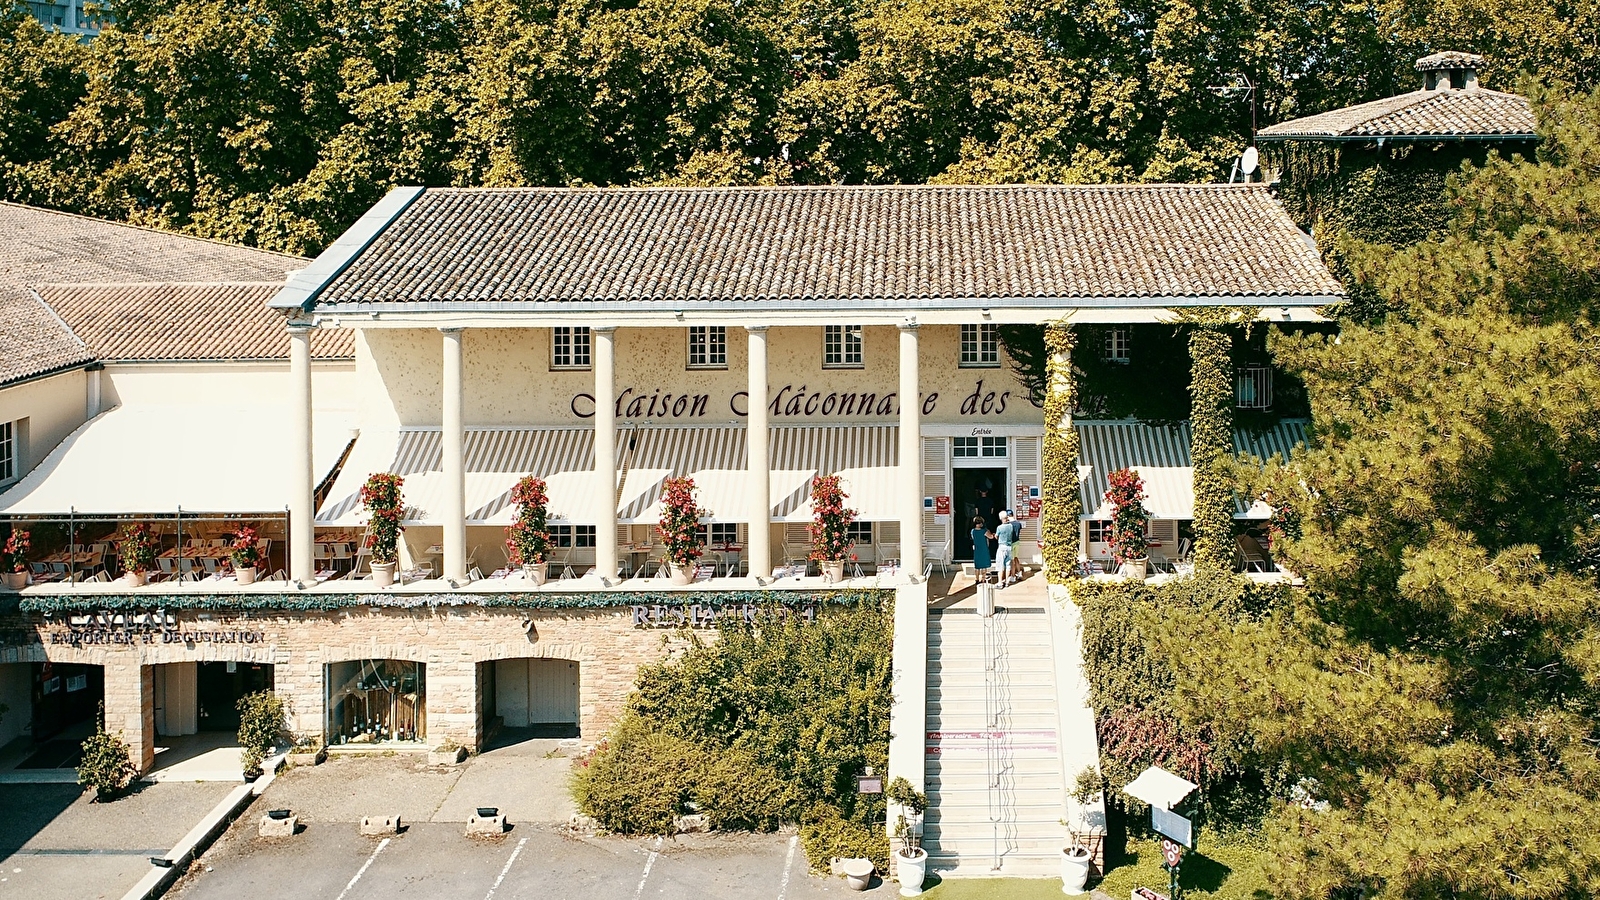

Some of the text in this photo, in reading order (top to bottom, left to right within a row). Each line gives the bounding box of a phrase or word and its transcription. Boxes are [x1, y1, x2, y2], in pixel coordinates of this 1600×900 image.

[960, 379, 1010, 416] des
[971, 427, 993, 437] Entrée
[66, 610, 176, 630] CAVEAU
[49, 631, 134, 645] EMPORTER
